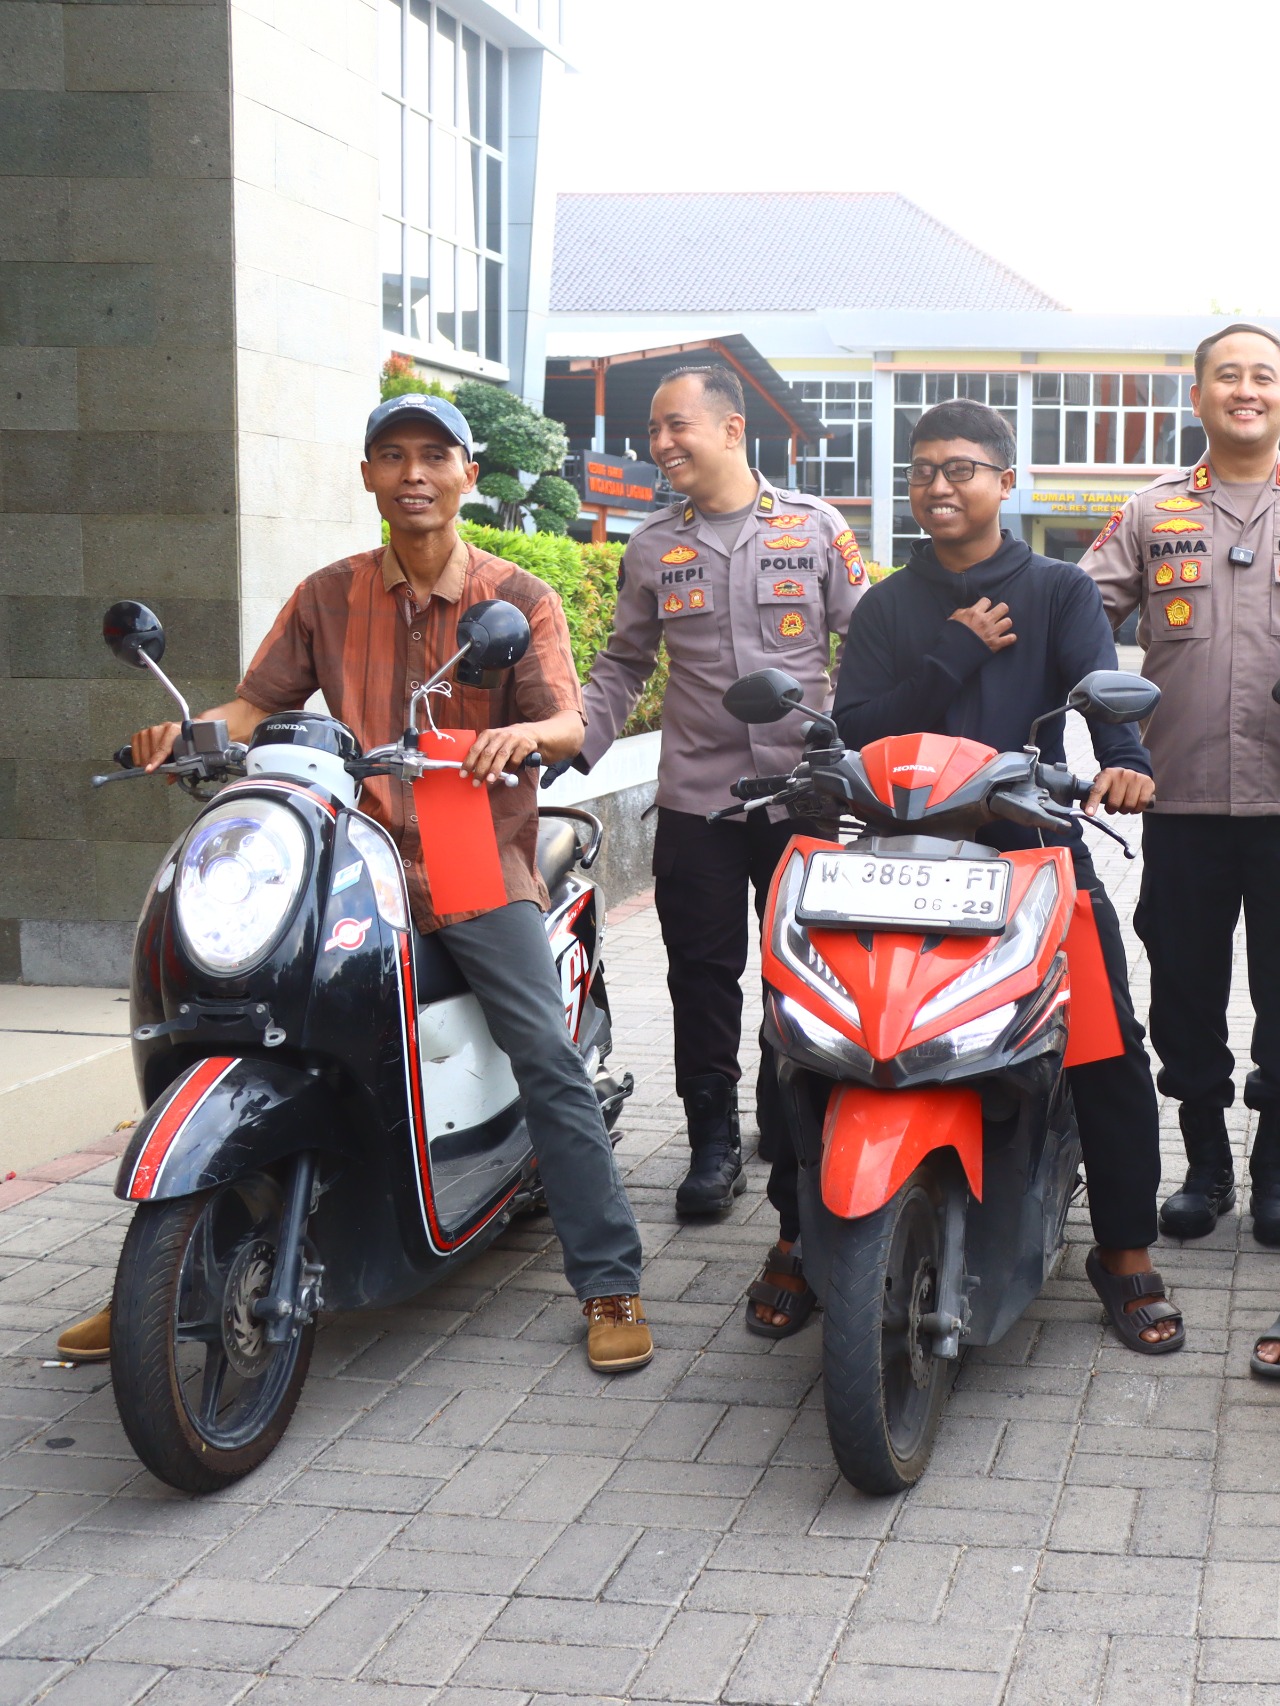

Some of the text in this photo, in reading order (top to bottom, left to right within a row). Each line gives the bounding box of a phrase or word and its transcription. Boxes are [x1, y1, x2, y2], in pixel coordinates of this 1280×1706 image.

[1032, 493, 1075, 503] RUMAH
[1051, 504, 1087, 512] POLRES
[1149, 540, 1207, 558] RAMA
[760, 557, 813, 571] POLRI
[661, 566, 704, 585] HEPI
[266, 723, 308, 733] HONDA
[892, 764, 936, 774] HONDA
[822, 861, 1002, 891] W 3865 FT
